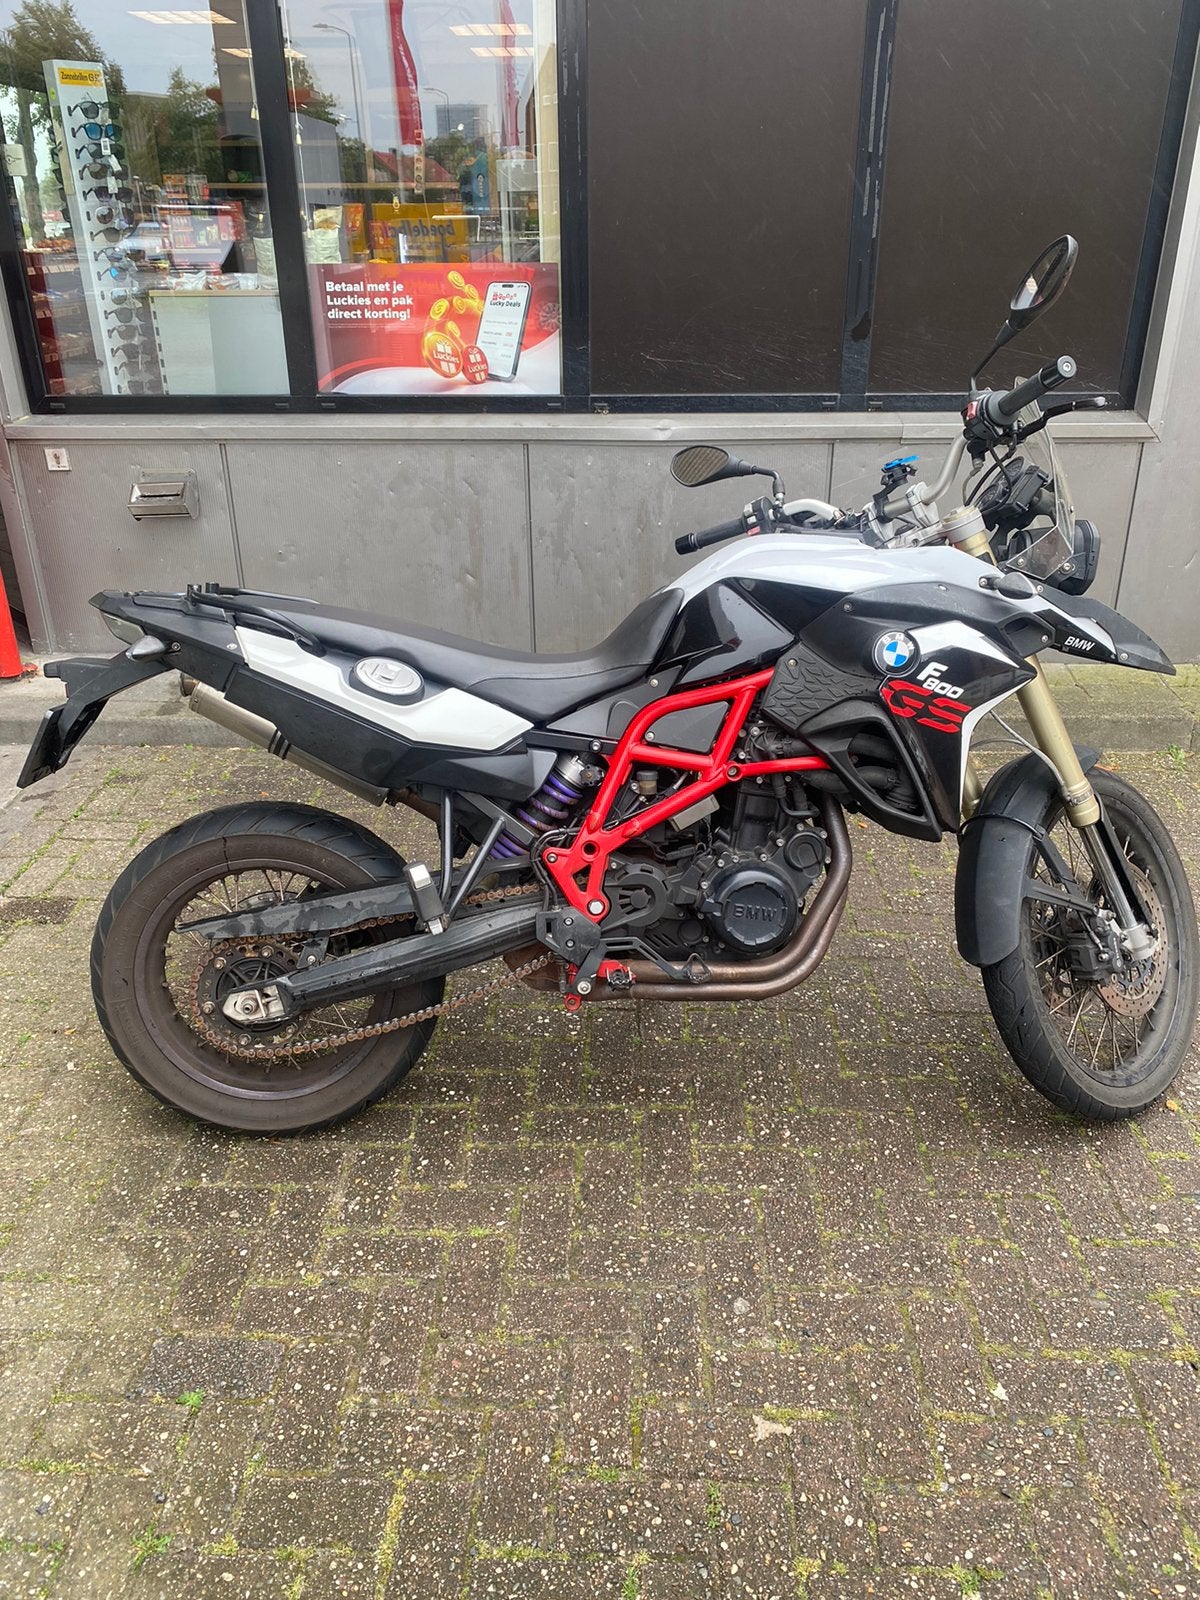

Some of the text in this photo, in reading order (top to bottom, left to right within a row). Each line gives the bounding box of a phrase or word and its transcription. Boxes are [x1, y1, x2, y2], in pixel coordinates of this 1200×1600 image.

[325, 280, 404, 294] Betaal met je
[326, 294, 414, 307] Luckies en pak
[490, 300, 504, 308] Lucky
[327, 308, 411, 321] direct korting!
[432, 349, 460, 364] Luckies
[467, 363, 488, 374] Luckies
[881, 633, 915, 651] BMW
[1064, 635, 1096, 651] BMW
[916, 661, 949, 681] F
[922, 677, 965, 699] 800
[880, 679, 973, 733] GS
[733, 903, 778, 922] BMW
